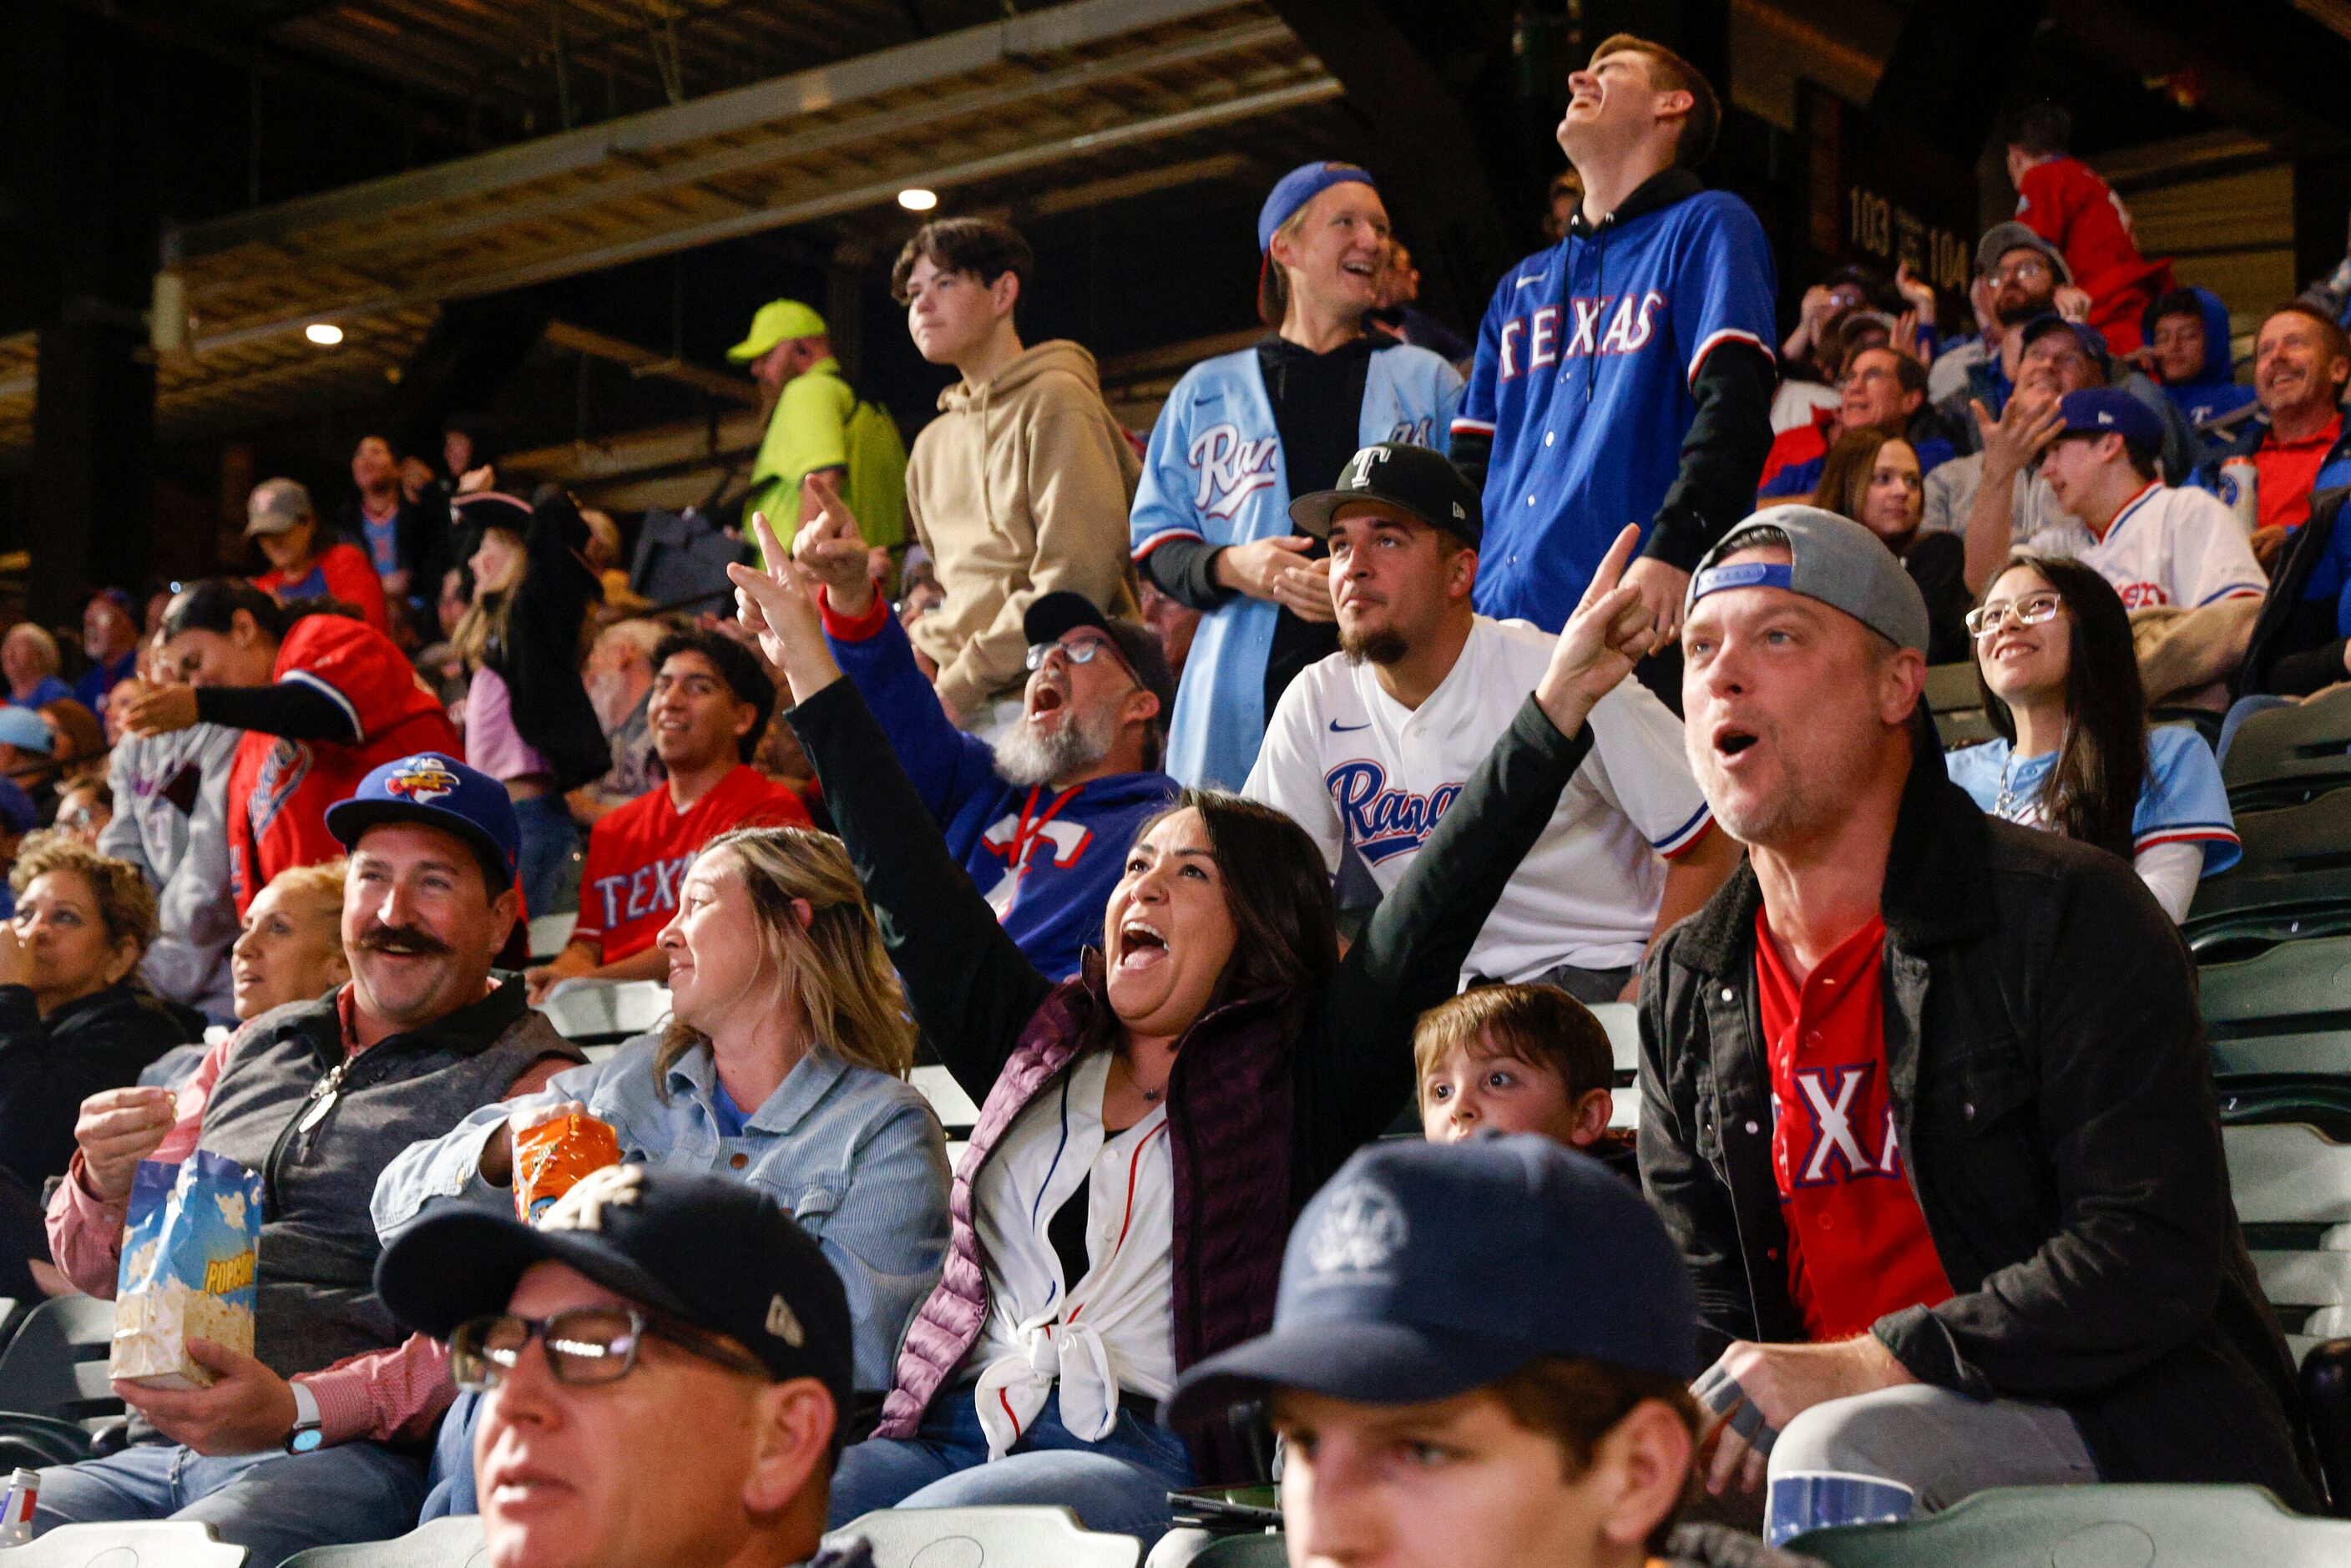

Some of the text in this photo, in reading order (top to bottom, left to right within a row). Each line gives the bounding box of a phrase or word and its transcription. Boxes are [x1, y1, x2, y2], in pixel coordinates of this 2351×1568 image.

[1851, 185, 1889, 256] 103
[1500, 289, 1668, 383] TEXAS
[1351, 446, 1392, 488] T
[982, 812, 1094, 924] T
